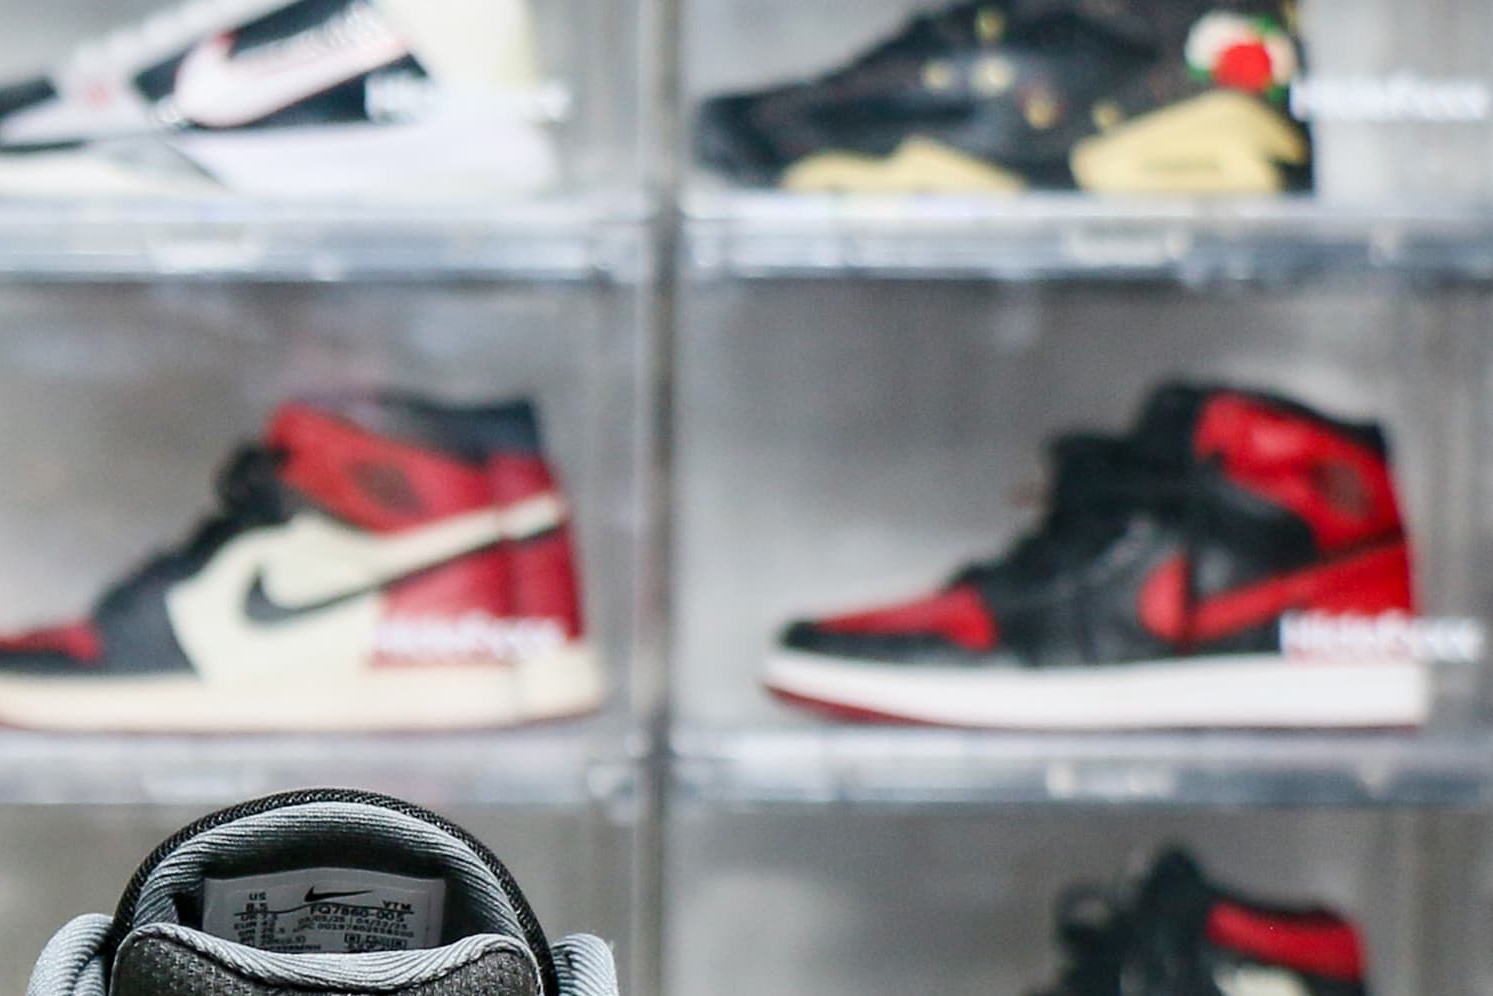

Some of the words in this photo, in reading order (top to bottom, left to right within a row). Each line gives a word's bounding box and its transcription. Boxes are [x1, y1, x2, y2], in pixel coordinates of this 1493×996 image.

[249, 892, 267, 901] US
[246, 902, 268, 914] 8.5
[383, 900, 413, 912] VTM
[310, 904, 406, 923] FQ7860-005
